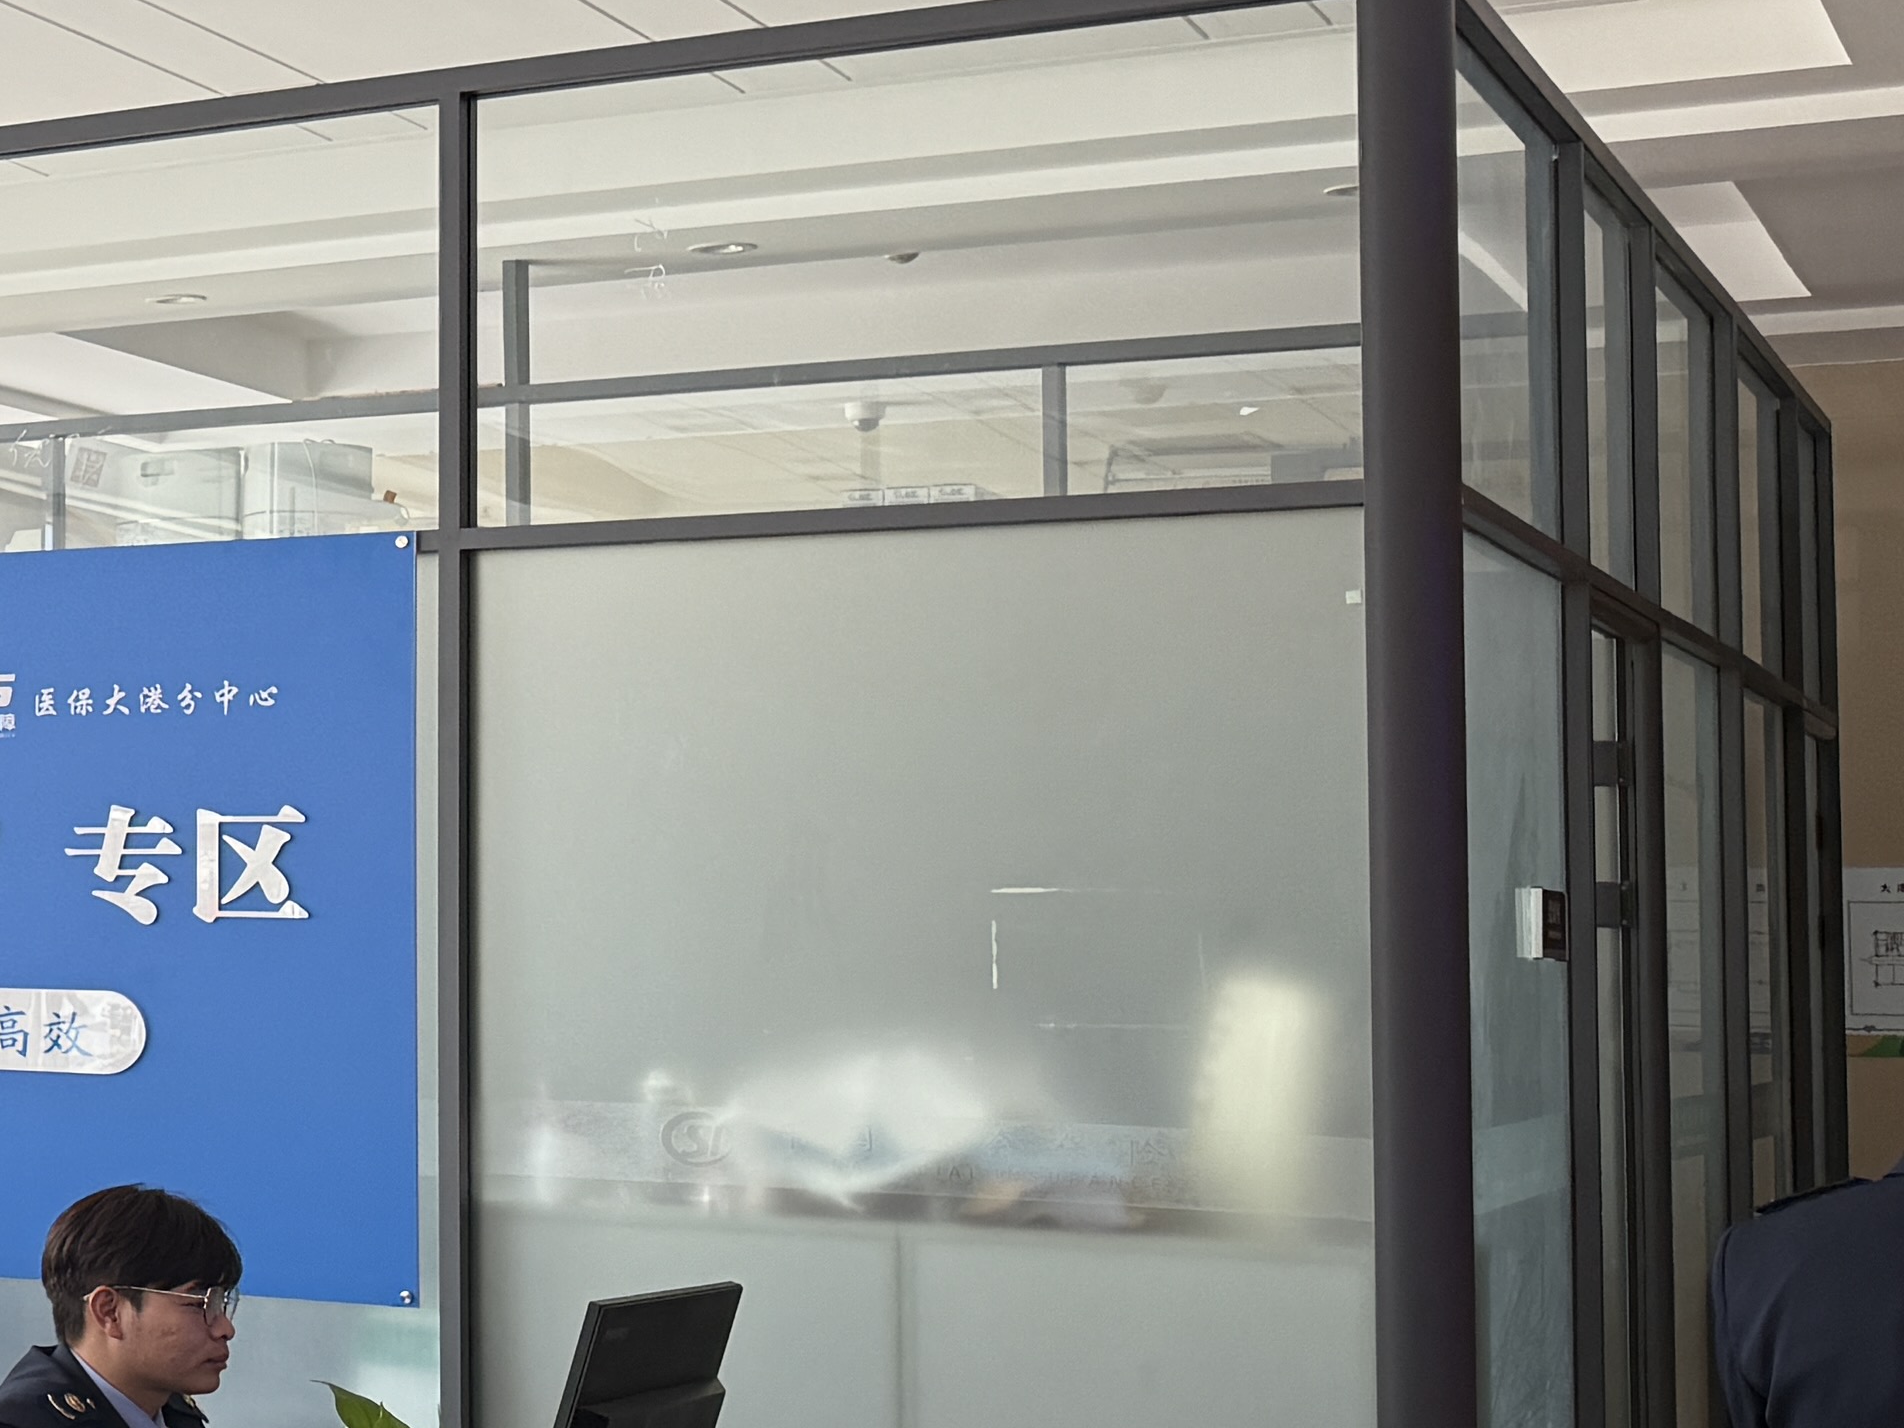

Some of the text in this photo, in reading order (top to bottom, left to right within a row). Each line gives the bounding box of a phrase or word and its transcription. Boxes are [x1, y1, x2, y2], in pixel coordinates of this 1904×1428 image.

[34, 680, 279, 716] 医保大港分中心
